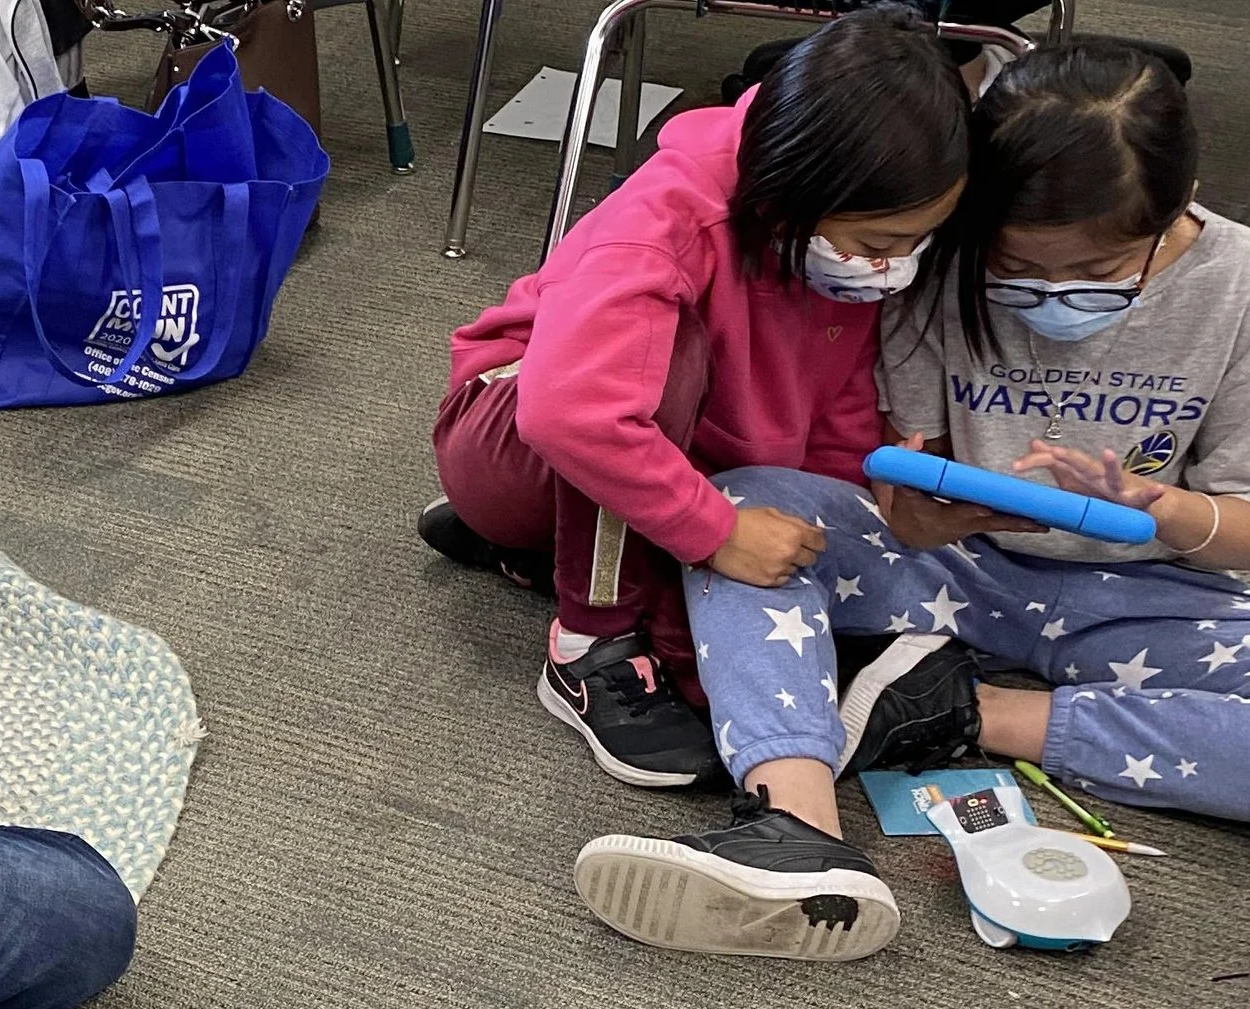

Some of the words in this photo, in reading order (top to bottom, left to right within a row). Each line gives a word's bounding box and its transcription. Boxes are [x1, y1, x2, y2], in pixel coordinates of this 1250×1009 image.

[99, 332, 132, 345] 2020
[84, 346, 113, 363] Office
[141, 365, 175, 385] Census
[989, 363, 1100, 386] GOLDEN
[1109, 371, 1188, 393] STATE
[950, 374, 1209, 428] WARRIORS
